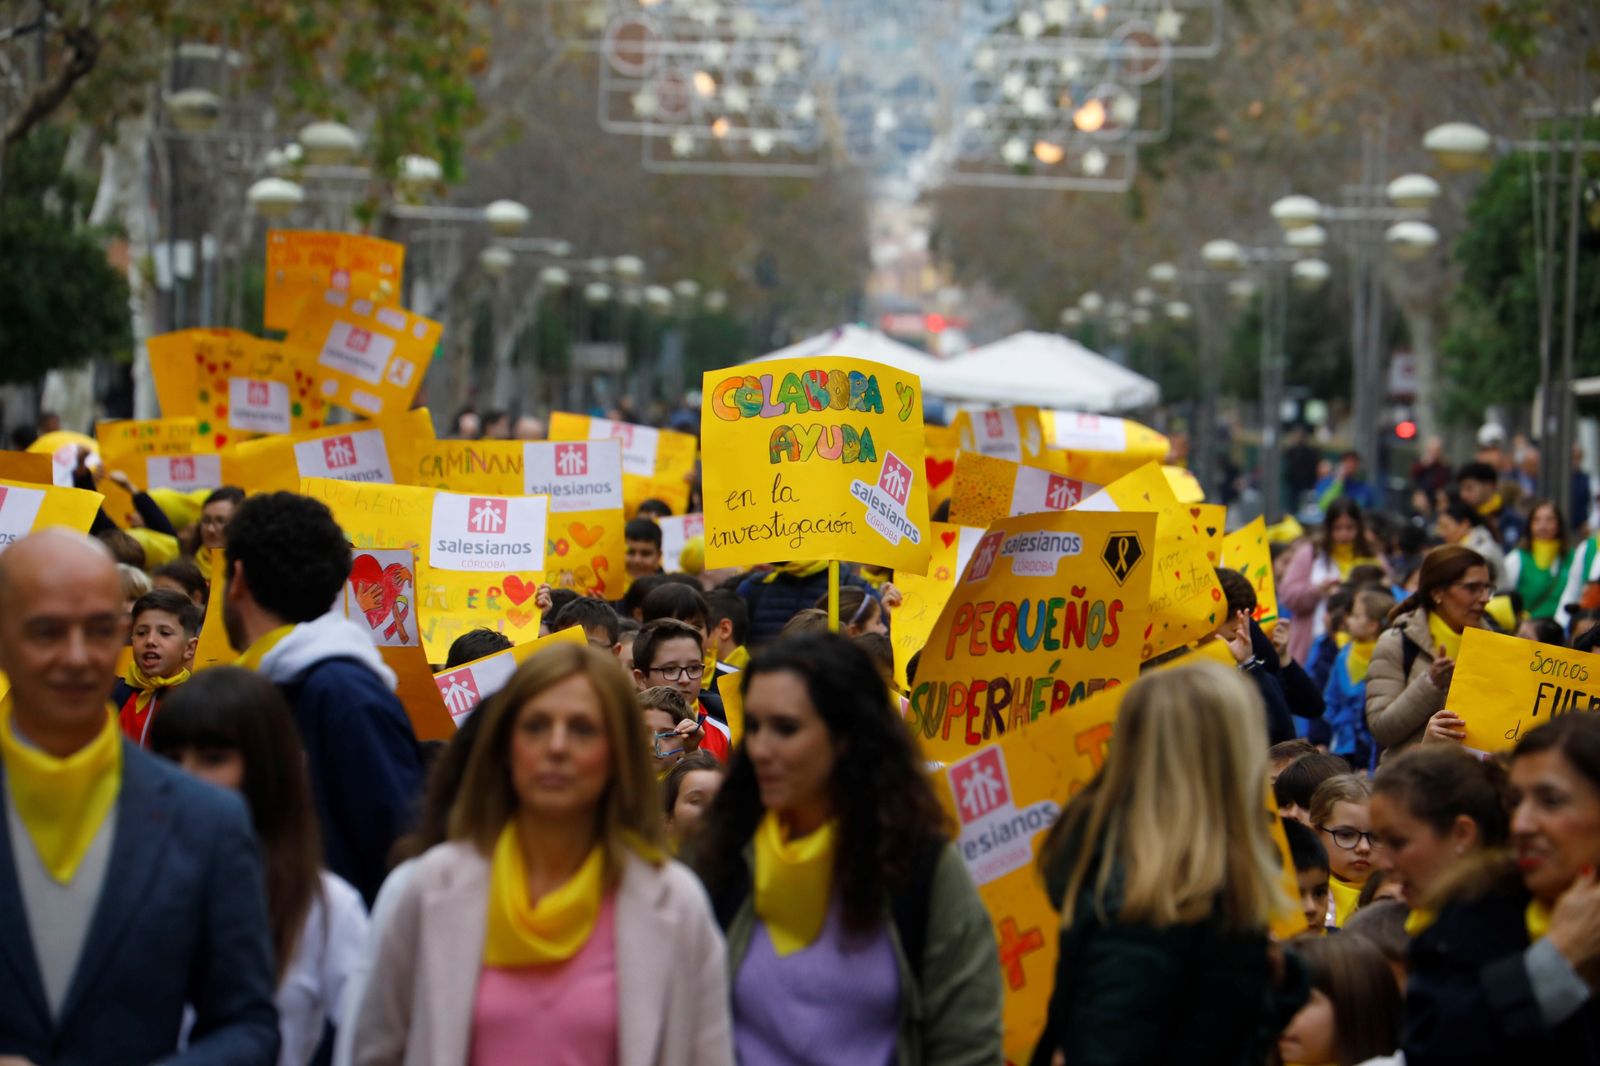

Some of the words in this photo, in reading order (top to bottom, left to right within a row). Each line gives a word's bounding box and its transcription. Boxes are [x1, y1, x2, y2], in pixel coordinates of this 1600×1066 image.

[712, 369, 884, 421] COLABORA
[769, 424, 878, 465] AYUDA
[531, 480, 613, 497] salesianos
[724, 488, 757, 511] en
[771, 472, 801, 504] la
[709, 511, 857, 550] investigación
[850, 480, 920, 544] salesianos
[865, 511, 900, 544] CÓRDOBA
[437, 538, 533, 556] salesianos
[1000, 530, 1081, 555] salesianos
[461, 558, 507, 570] CÓRDOBA
[1174, 562, 1214, 602] contra
[945, 586, 1124, 661] PEQUEÑOS
[910, 659, 1121, 746] SUPERHÉR
[963, 803, 1058, 862] esianos
